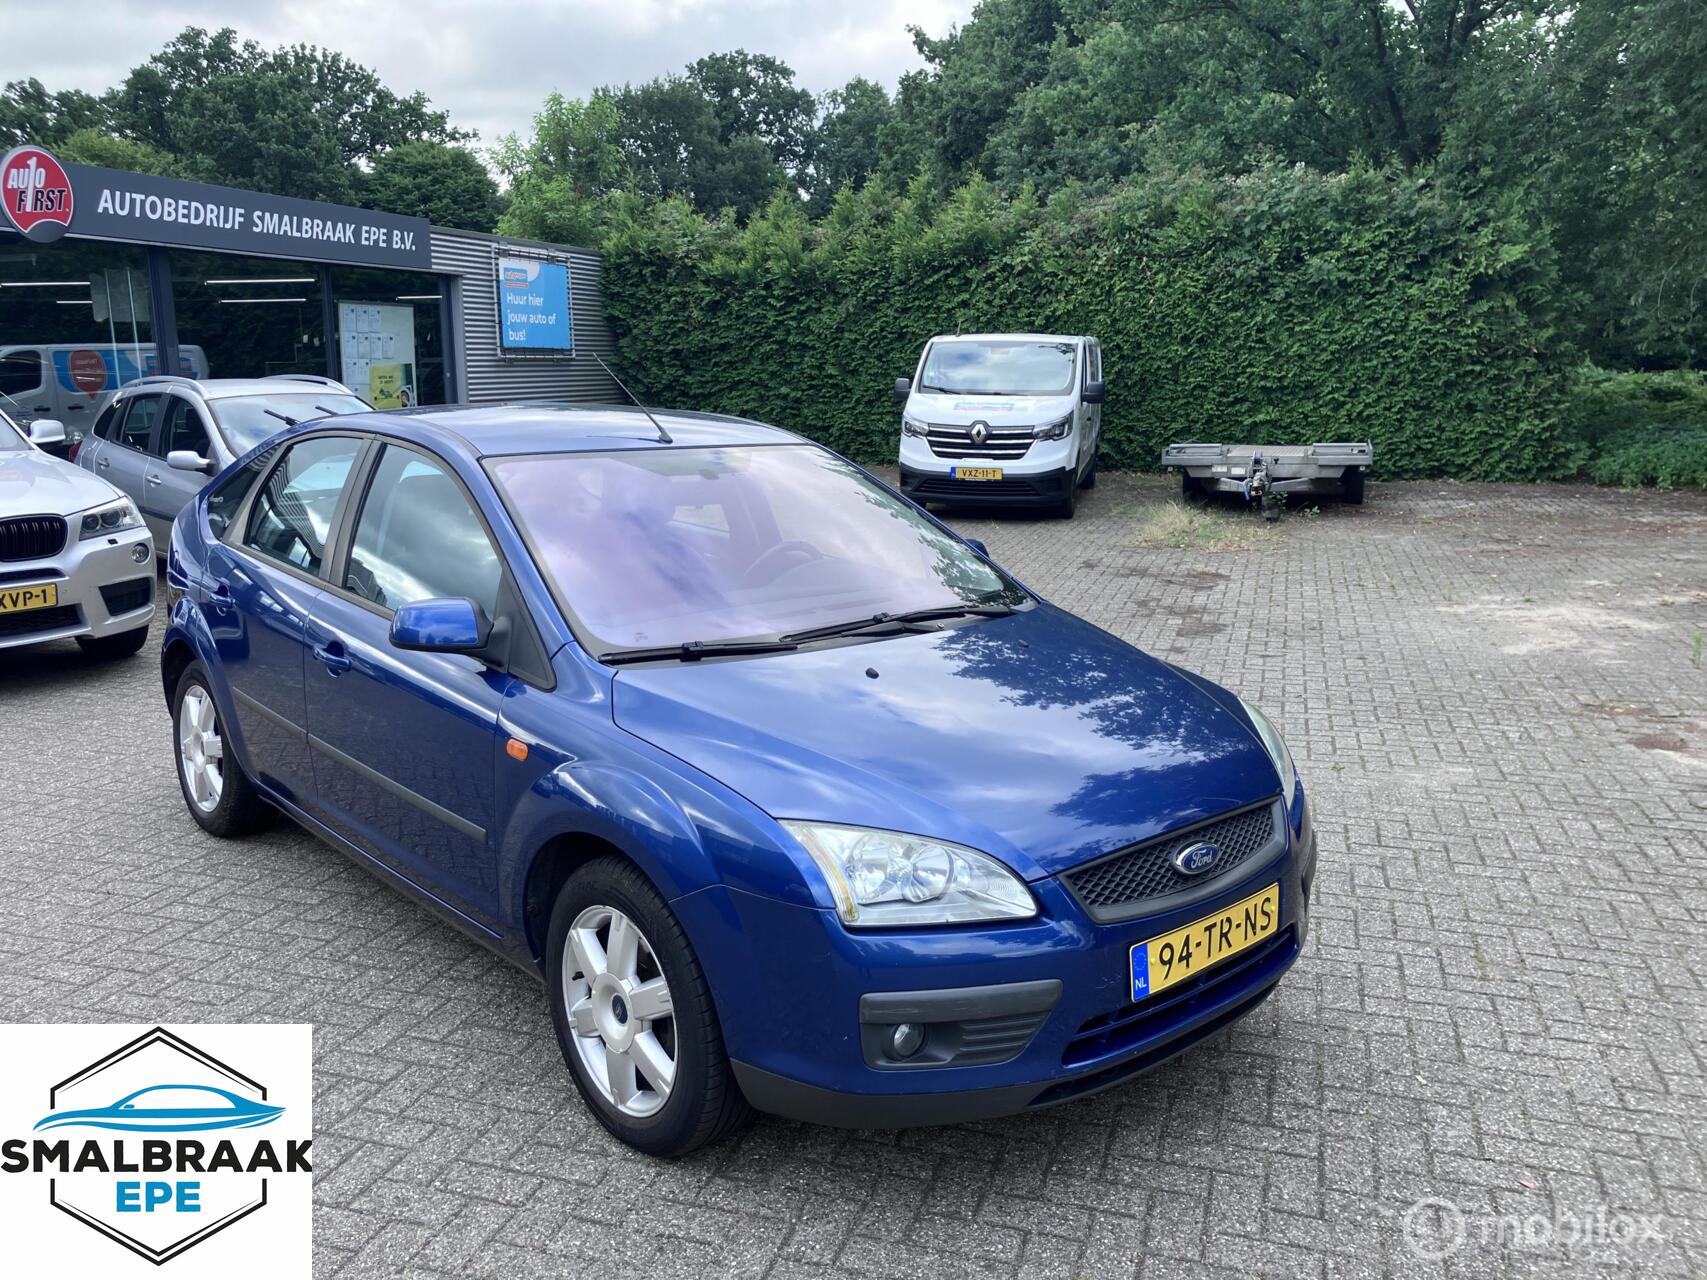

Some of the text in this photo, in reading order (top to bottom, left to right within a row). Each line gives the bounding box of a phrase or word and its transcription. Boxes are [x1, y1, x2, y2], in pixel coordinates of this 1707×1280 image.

[97, 188, 416, 251] AUTOBEDRIJF SMALBRAAK EPE B.V.
[507, 292, 544, 306] Huur hier
[507, 310, 556, 325] jouw auto of
[509, 329, 526, 341] bus!
[962, 469, 997, 478] VXZ-11-T
[1190, 850, 1213, 869] Ford
[1158, 896, 1272, 981] 94-TR-NS
[1135, 976, 1147, 991] NL
